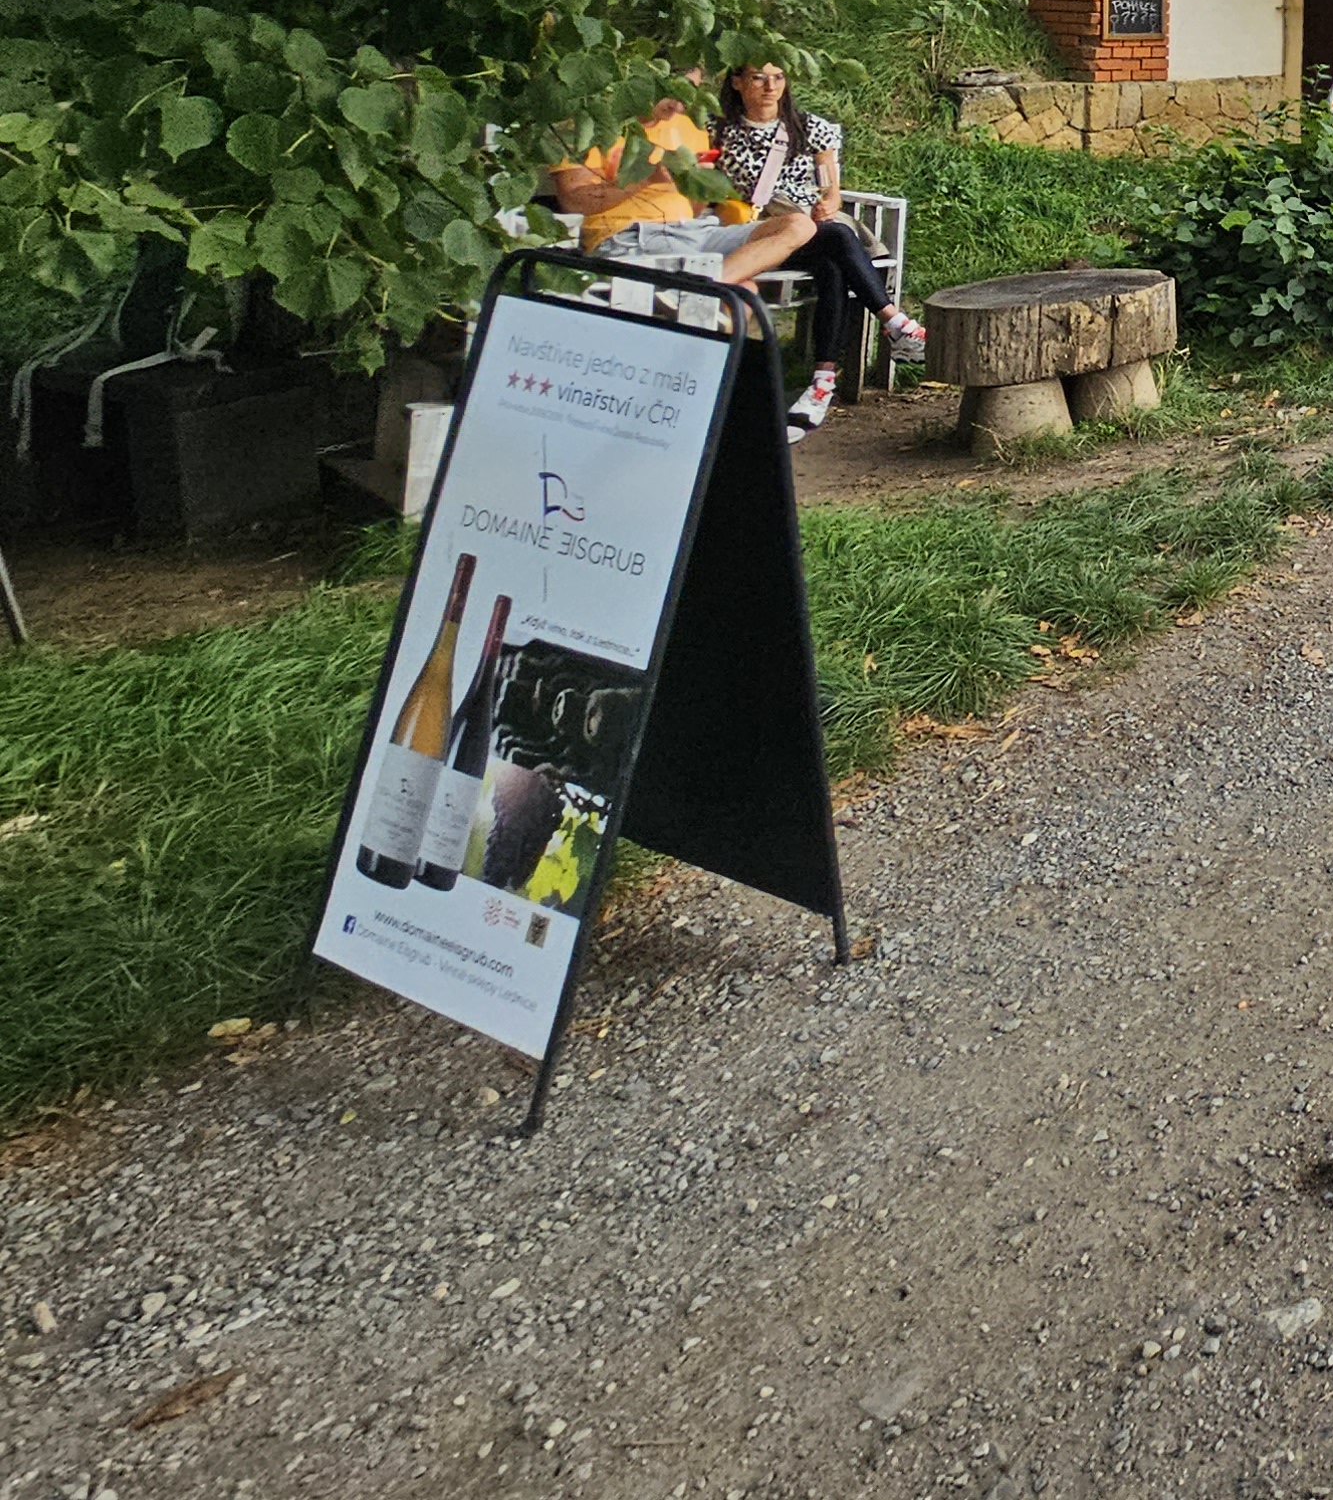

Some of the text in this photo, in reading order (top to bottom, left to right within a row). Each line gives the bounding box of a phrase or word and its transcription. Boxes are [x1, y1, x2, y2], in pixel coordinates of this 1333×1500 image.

[582, 355, 636, 381] jedno
[638, 368, 650, 385] z
[652, 371, 698, 396] mála
[634, 404, 647, 420] v
[647, 399, 682, 429] ČR!
[460, 504, 554, 551] DOMAINE
